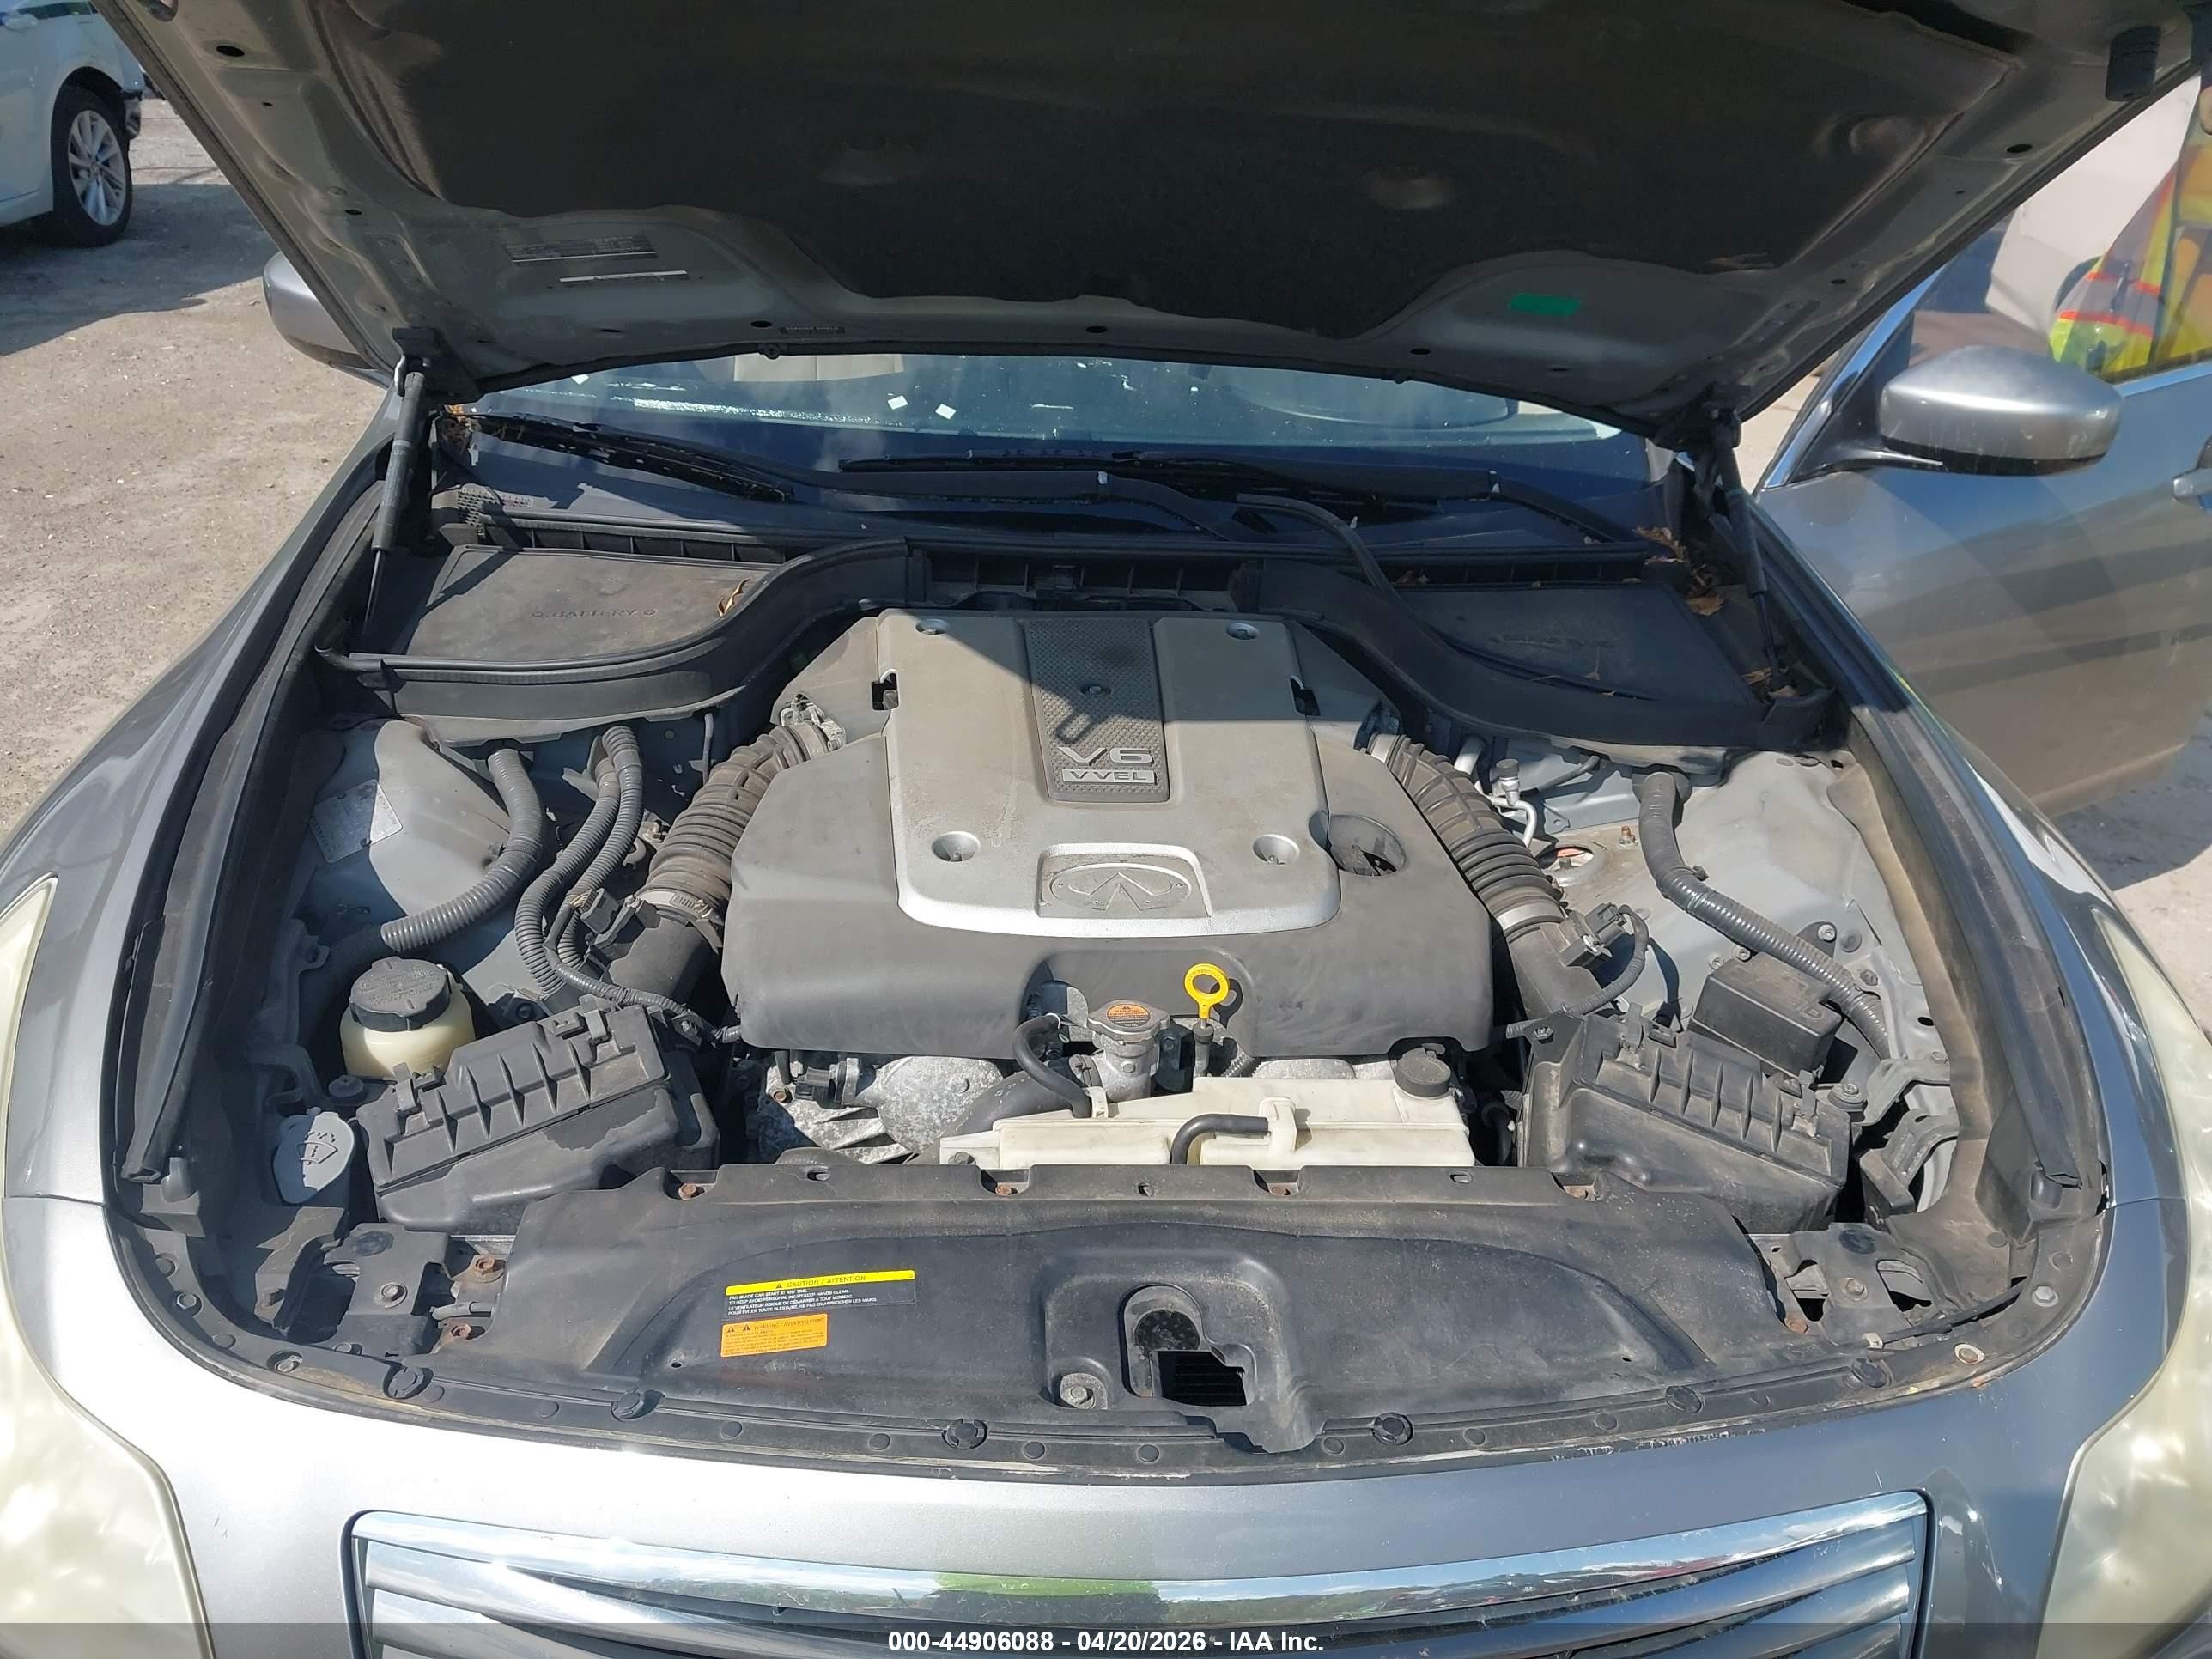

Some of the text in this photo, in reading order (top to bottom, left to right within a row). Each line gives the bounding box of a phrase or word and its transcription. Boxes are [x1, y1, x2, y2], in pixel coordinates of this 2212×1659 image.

[551, 609, 639, 618] BATTERY
[1057, 746, 1154, 764] V6
[1069, 771, 1148, 781] VVEL
[787, 1279, 819, 1288] CAUTION
[827, 1275, 866, 1285] ATTENTION
